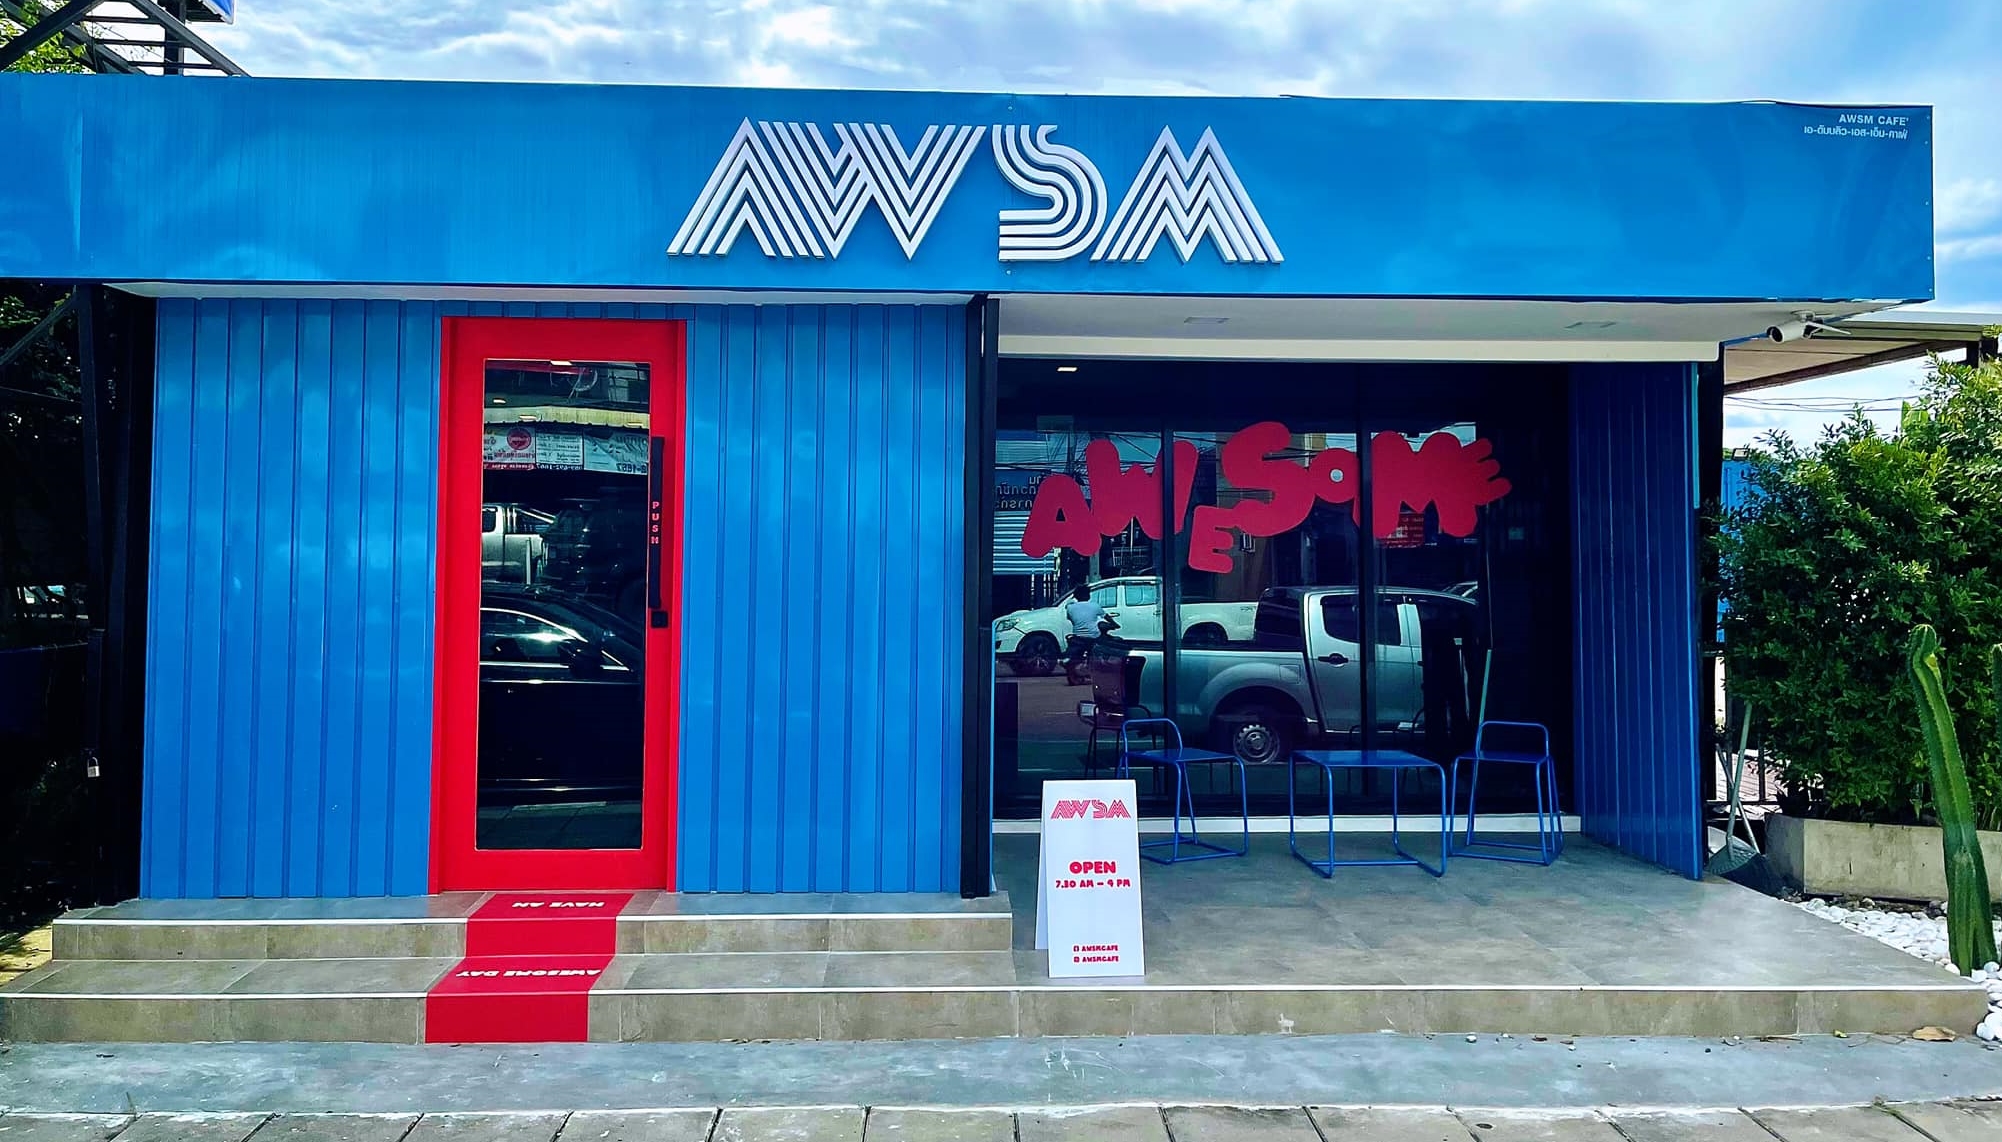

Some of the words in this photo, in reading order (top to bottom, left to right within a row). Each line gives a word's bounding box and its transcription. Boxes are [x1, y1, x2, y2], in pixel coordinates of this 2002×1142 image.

[1839, 114, 1874, 124] AWSM
[666, 116, 1285, 264] AWSM
[651, 501, 660, 545] PUSH
[1050, 799, 1131, 819] AWSM
[1069, 861, 1117, 874] OPEN
[1055, 879, 1077, 889] 7.30
[1080, 879, 1095, 888] AM
[1117, 879, 1131, 888] PM
[503, 969, 602, 977] AWESOME
